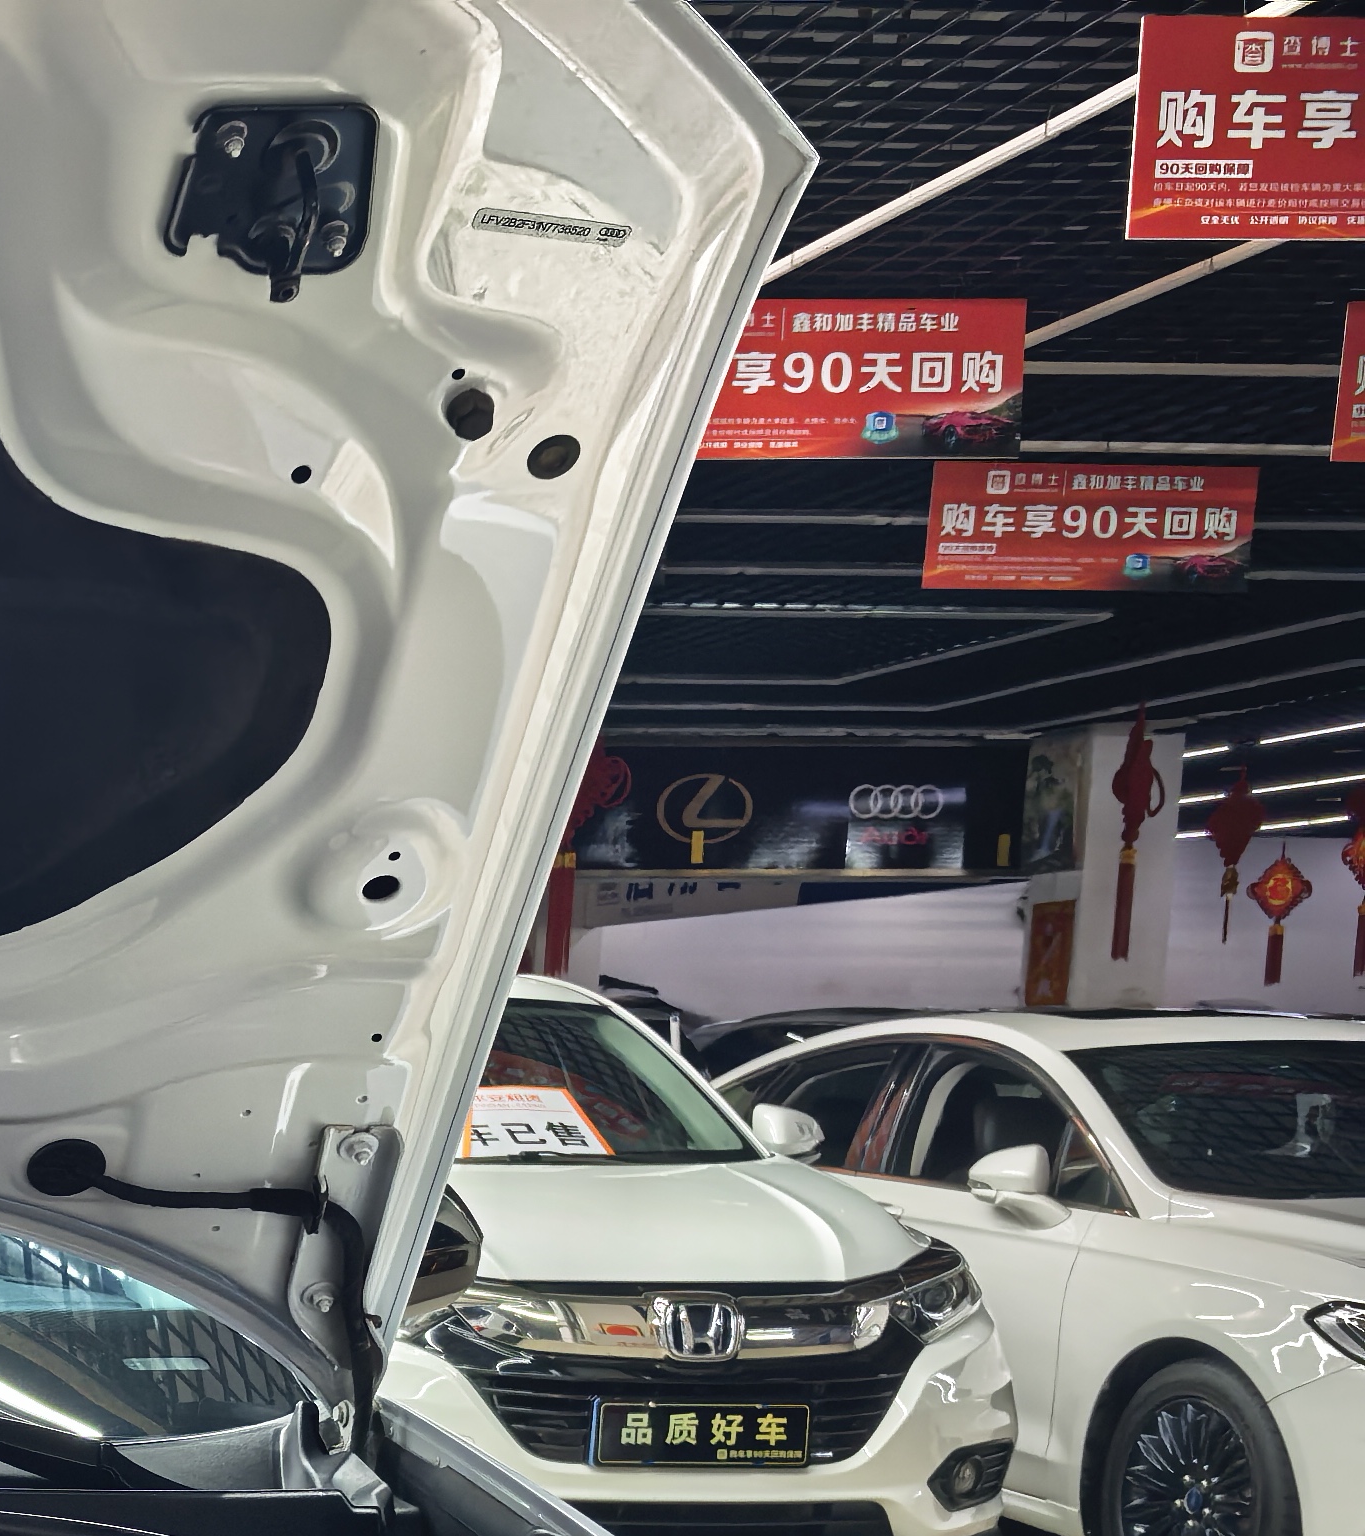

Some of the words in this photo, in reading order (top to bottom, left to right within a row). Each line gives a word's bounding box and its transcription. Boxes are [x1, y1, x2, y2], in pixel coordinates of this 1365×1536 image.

[1157, 89, 1361, 150] 购车享
[732, 350, 1004, 395] 享90天回购
[940, 503, 1239, 541] 购车享90天回购
[620, 1412, 788, 1446] 品质好车
